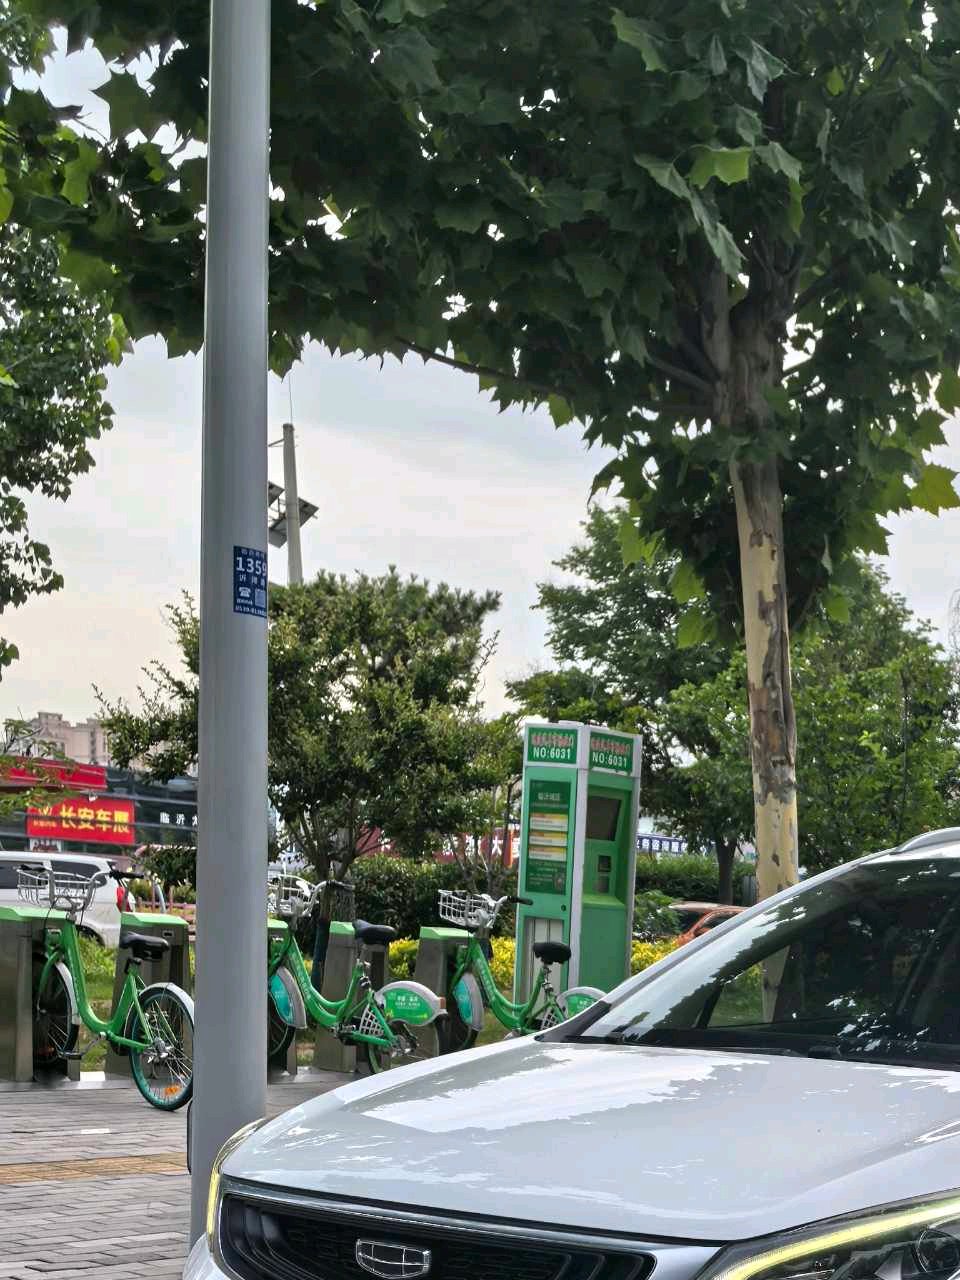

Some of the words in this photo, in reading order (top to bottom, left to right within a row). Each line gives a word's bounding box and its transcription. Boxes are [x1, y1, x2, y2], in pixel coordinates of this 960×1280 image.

[533, 747, 571, 760] NO:6031
[592, 751, 627, 768] NO:6031
[60, 804, 130, 833] 长安车展
